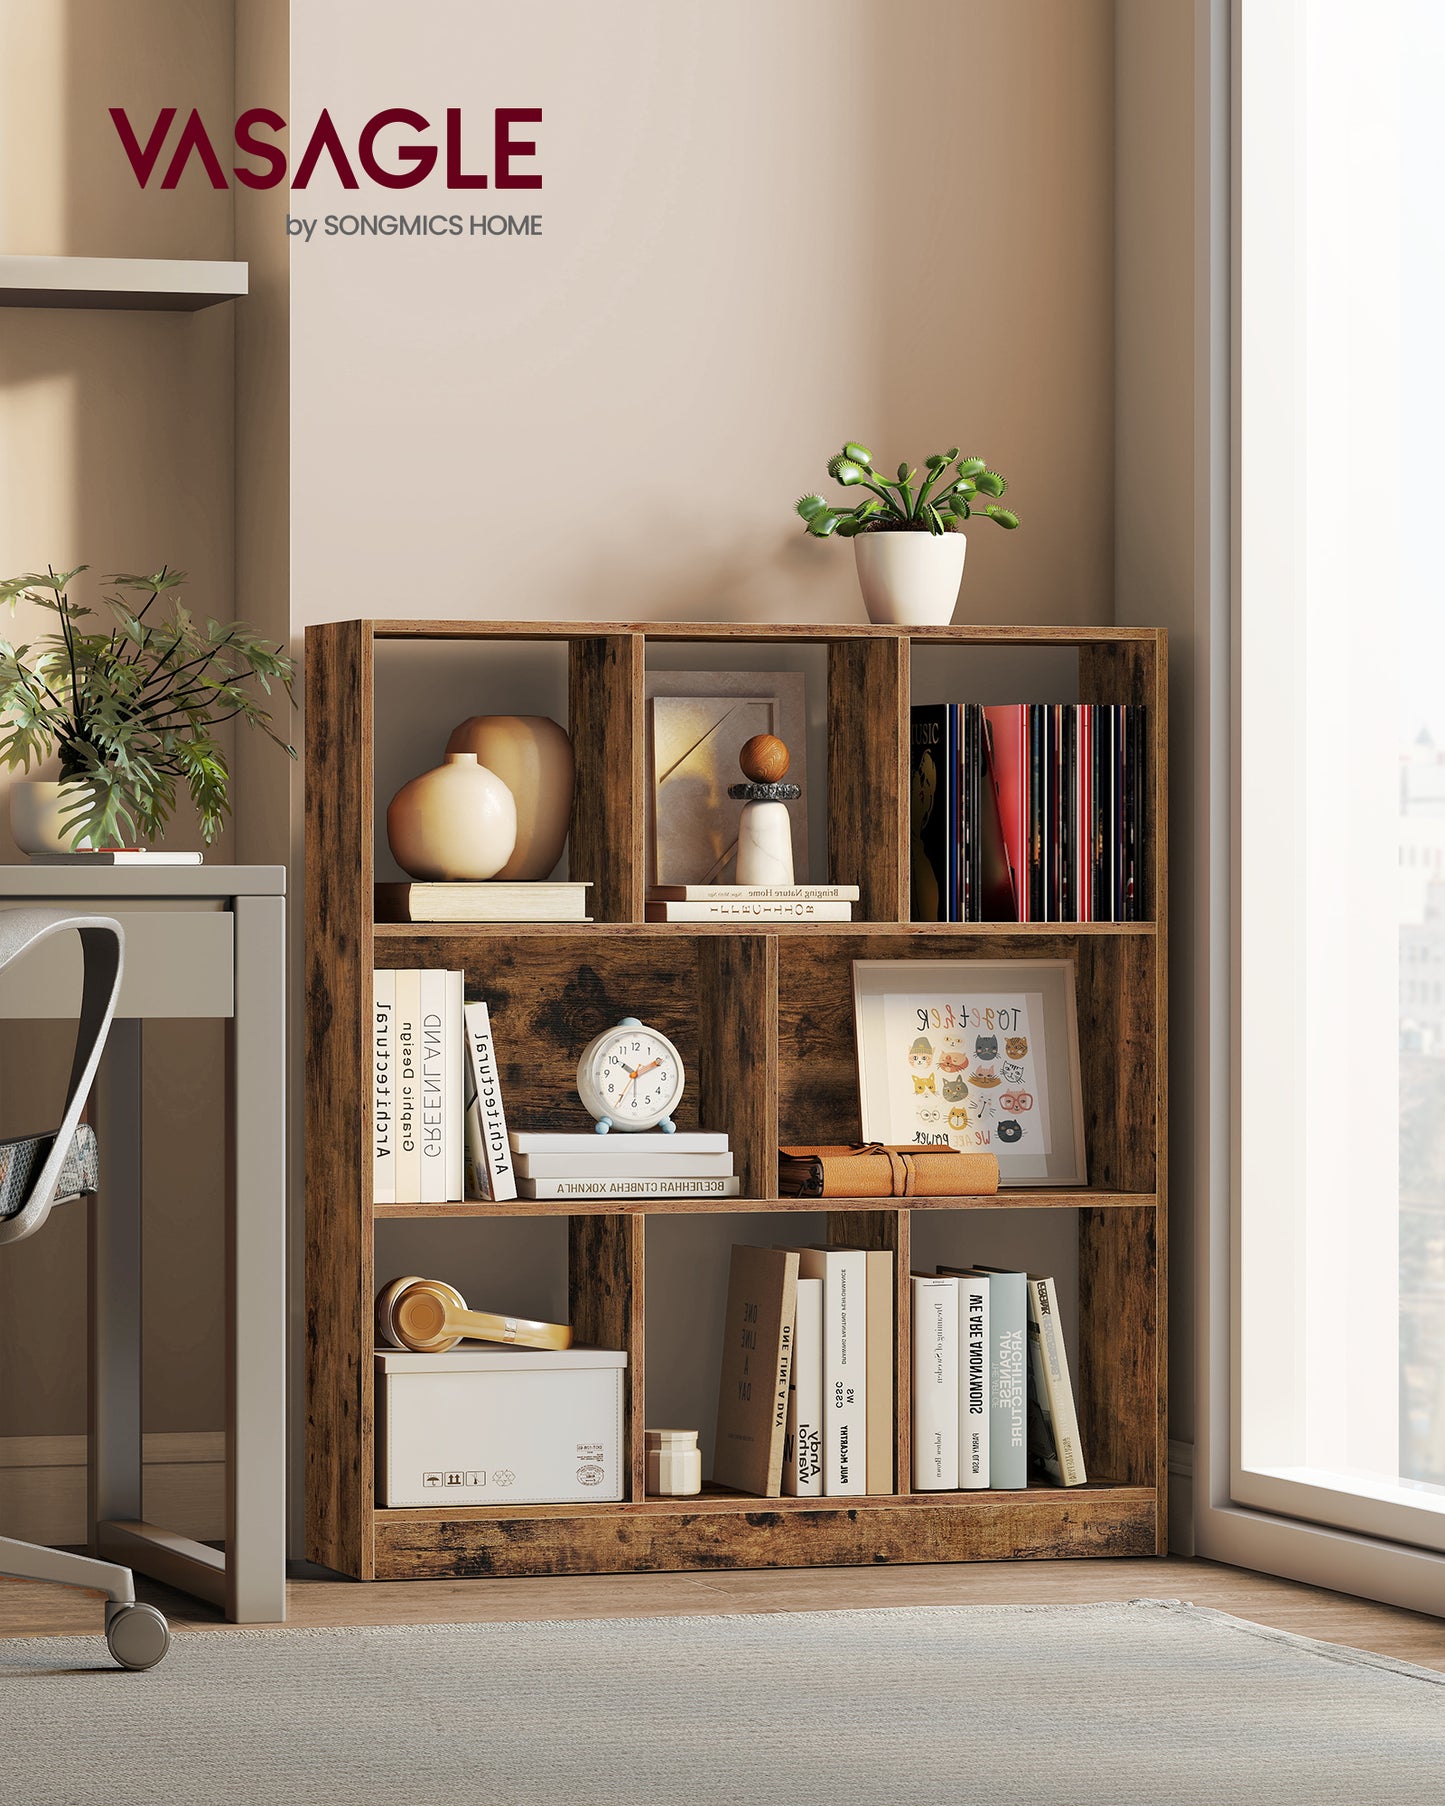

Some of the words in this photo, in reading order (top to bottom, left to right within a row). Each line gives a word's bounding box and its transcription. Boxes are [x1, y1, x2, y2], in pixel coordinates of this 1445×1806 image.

[911, 722, 940, 745] USIC
[620, 1046, 627, 1054] 11
[631, 1042, 641, 1051] 12
[647, 1047, 651, 1055] 1
[608, 1056, 618, 1065] 10
[604, 1069, 610, 1078] 9
[660, 1072, 667, 1081] 3
[607, 1083, 615, 1093] 8
[655, 1086, 661, 1095] 4
[631, 1098, 637, 1108] 6
[644, 1095, 651, 1104] 5
